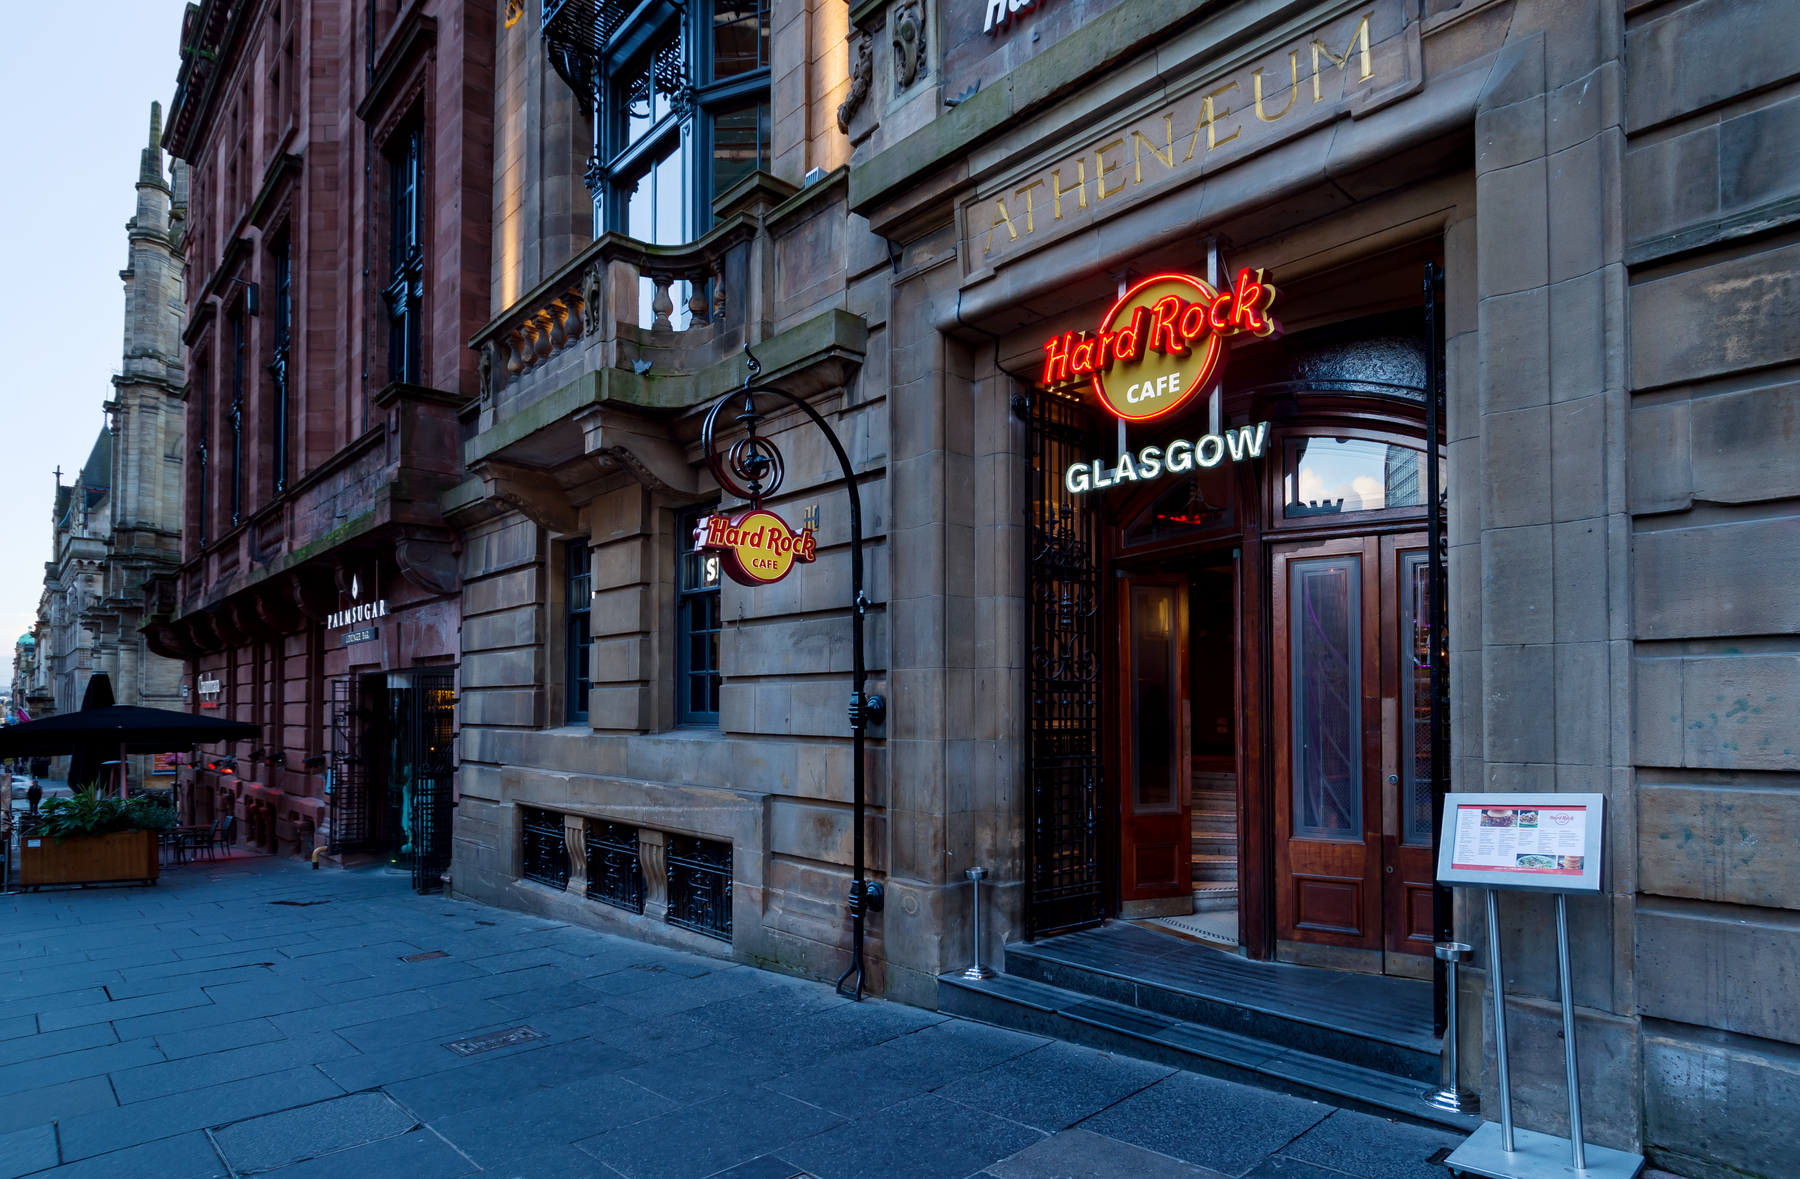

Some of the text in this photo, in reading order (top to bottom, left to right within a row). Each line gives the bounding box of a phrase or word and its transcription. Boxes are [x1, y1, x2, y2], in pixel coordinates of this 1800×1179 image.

[1042, 267, 1268, 386] Hard Rock
[1126, 371, 1181, 404] CAFE
[1065, 421, 1271, 494] GLASGOW
[708, 517, 765, 549] Hard
[766, 527, 816, 562] Rock
[751, 558, 778, 570] CAFE
[327, 599, 386, 630] PALMSUGAR
